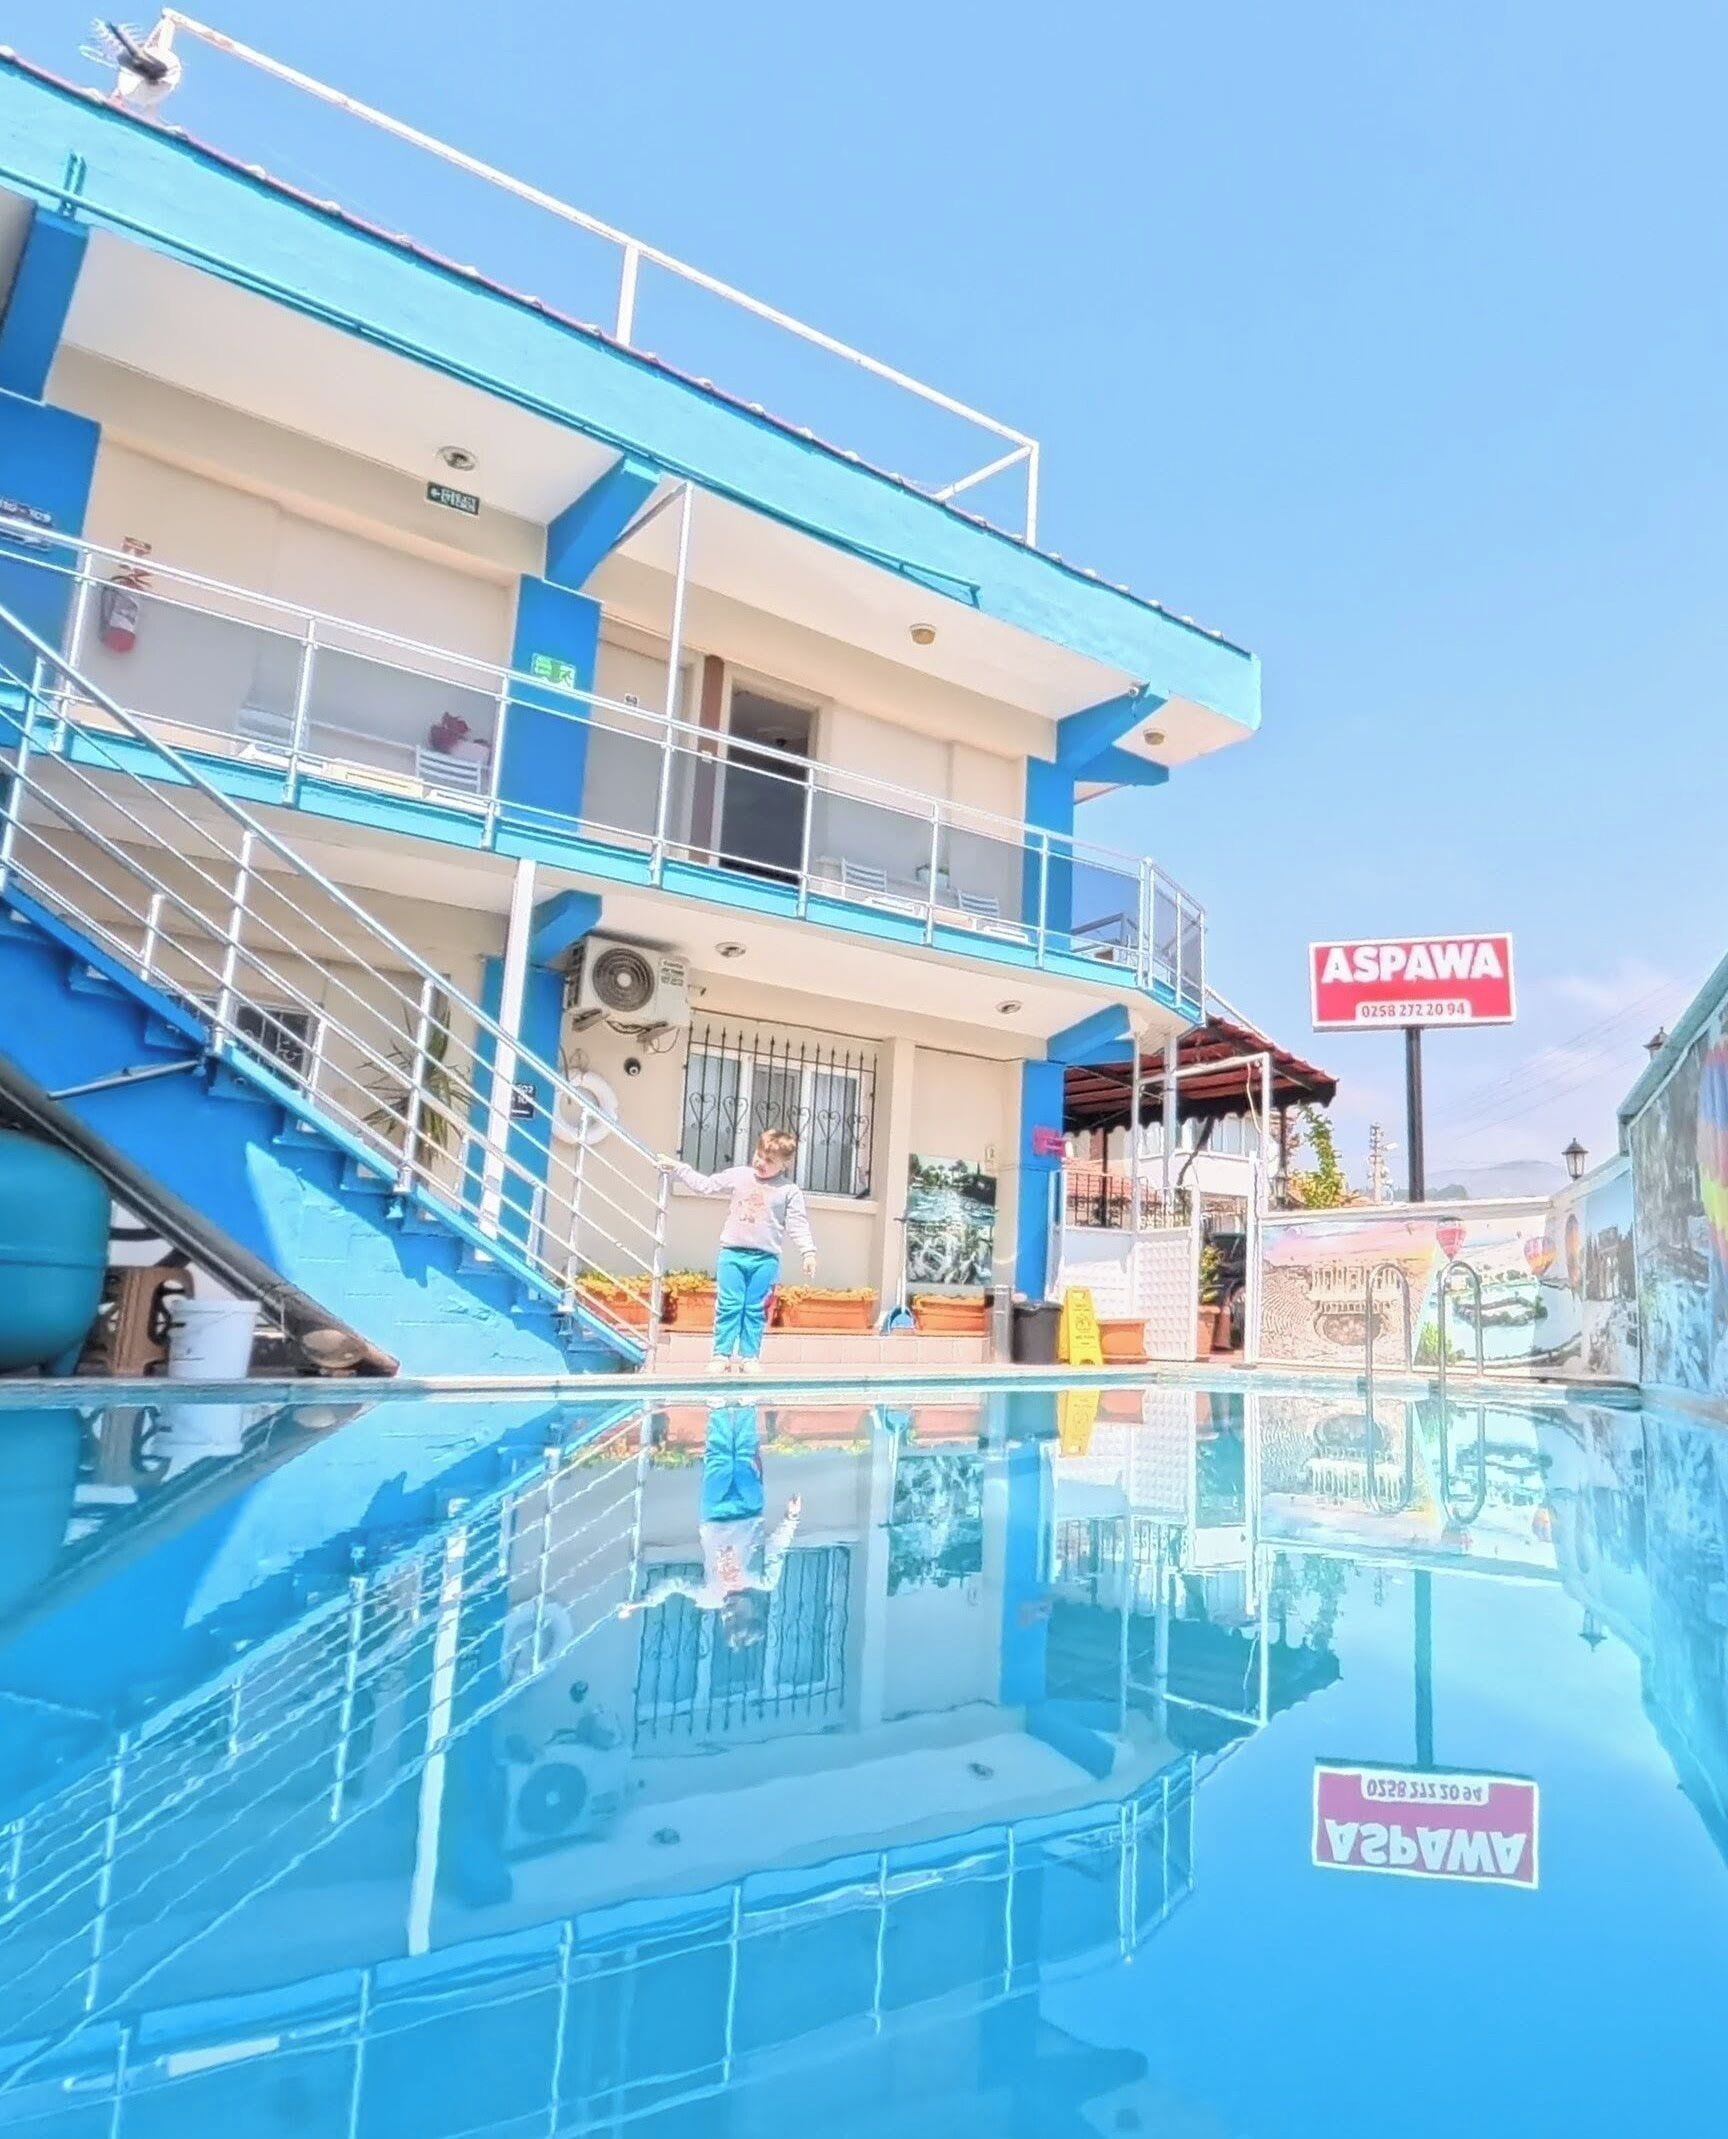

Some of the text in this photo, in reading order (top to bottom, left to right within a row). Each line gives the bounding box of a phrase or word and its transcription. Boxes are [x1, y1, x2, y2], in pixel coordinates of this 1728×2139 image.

[1320, 942, 1504, 984] ASPAWA
[1362, 1002, 1465, 1018] 0258 272 20 94
